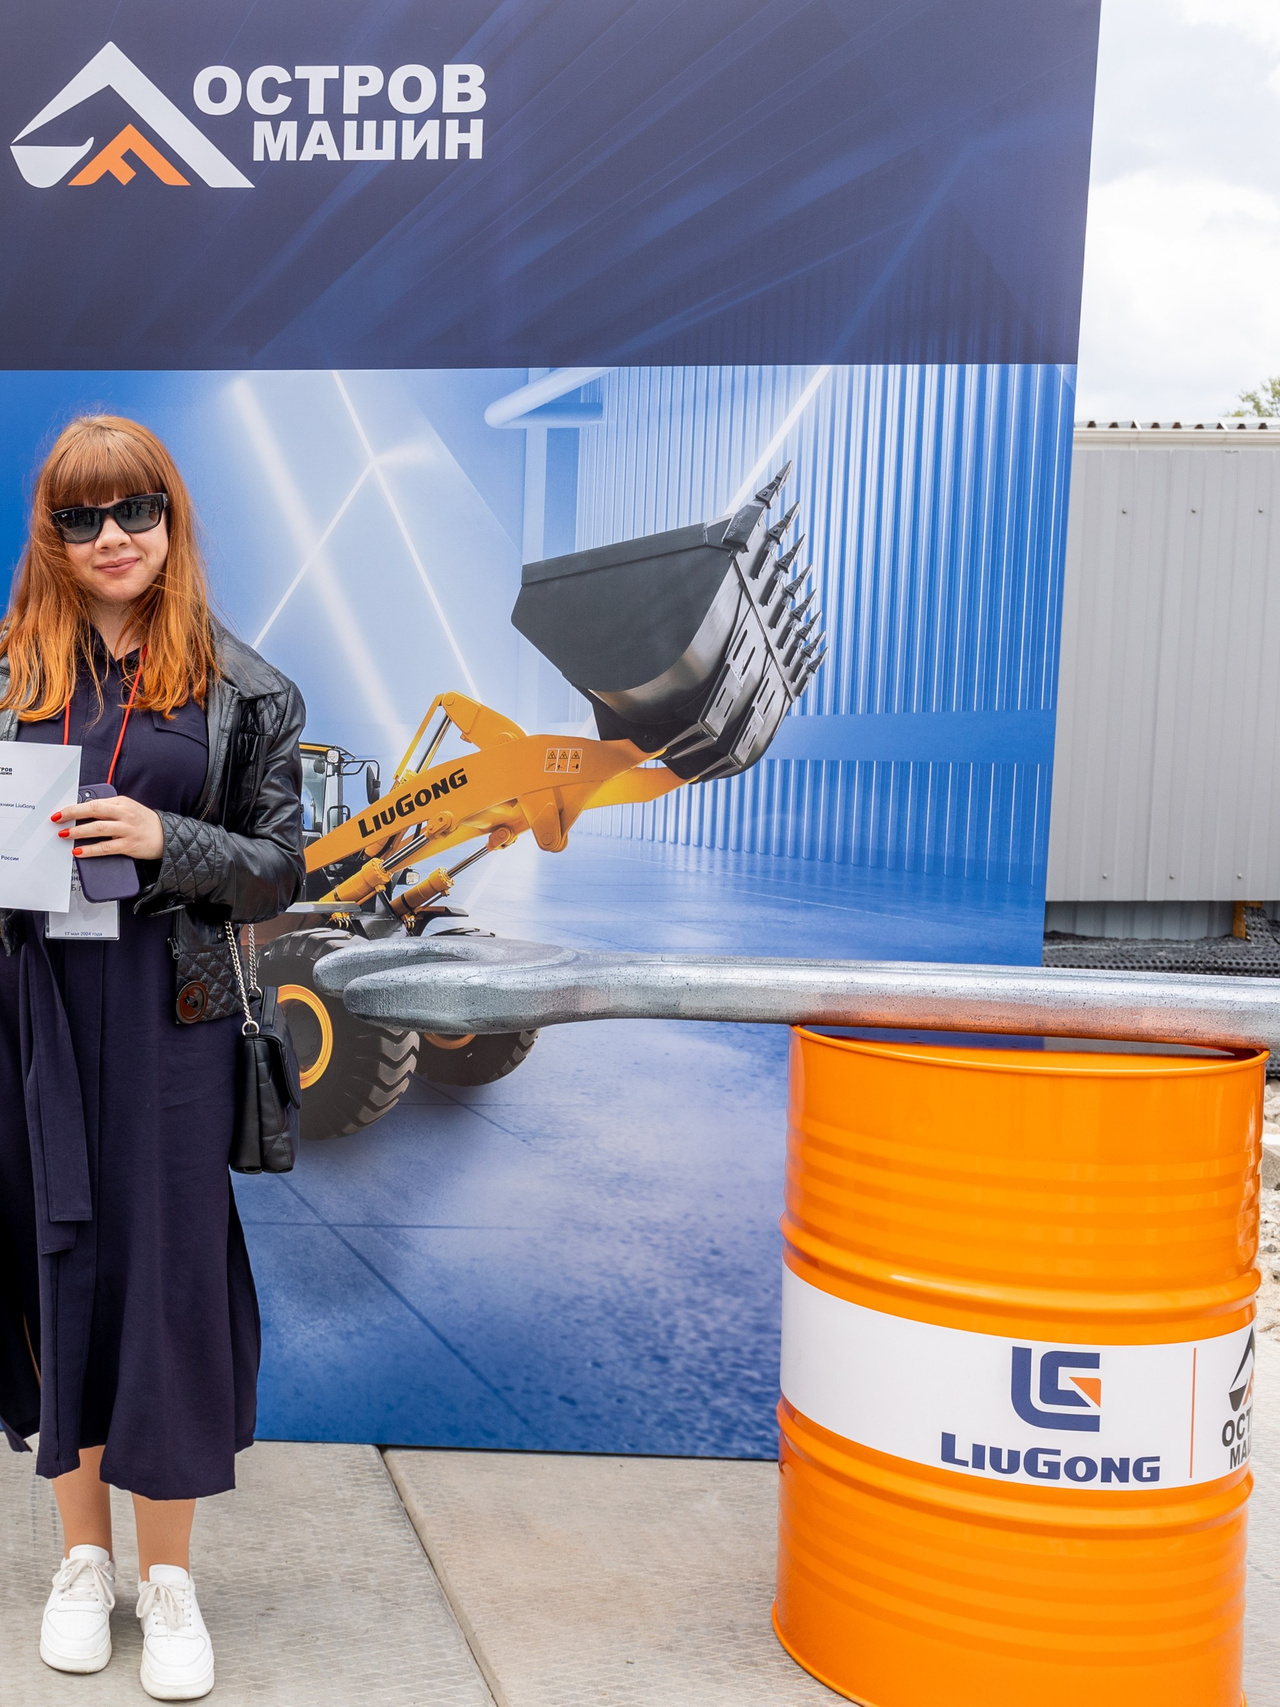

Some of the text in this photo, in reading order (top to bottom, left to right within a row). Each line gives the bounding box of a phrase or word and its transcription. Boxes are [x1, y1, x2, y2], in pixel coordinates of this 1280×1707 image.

[193, 64, 487, 115] ОСТРОВ
[253, 119, 484, 161] МАШИН
[1222, 1407, 1252, 1447] ОСТ
